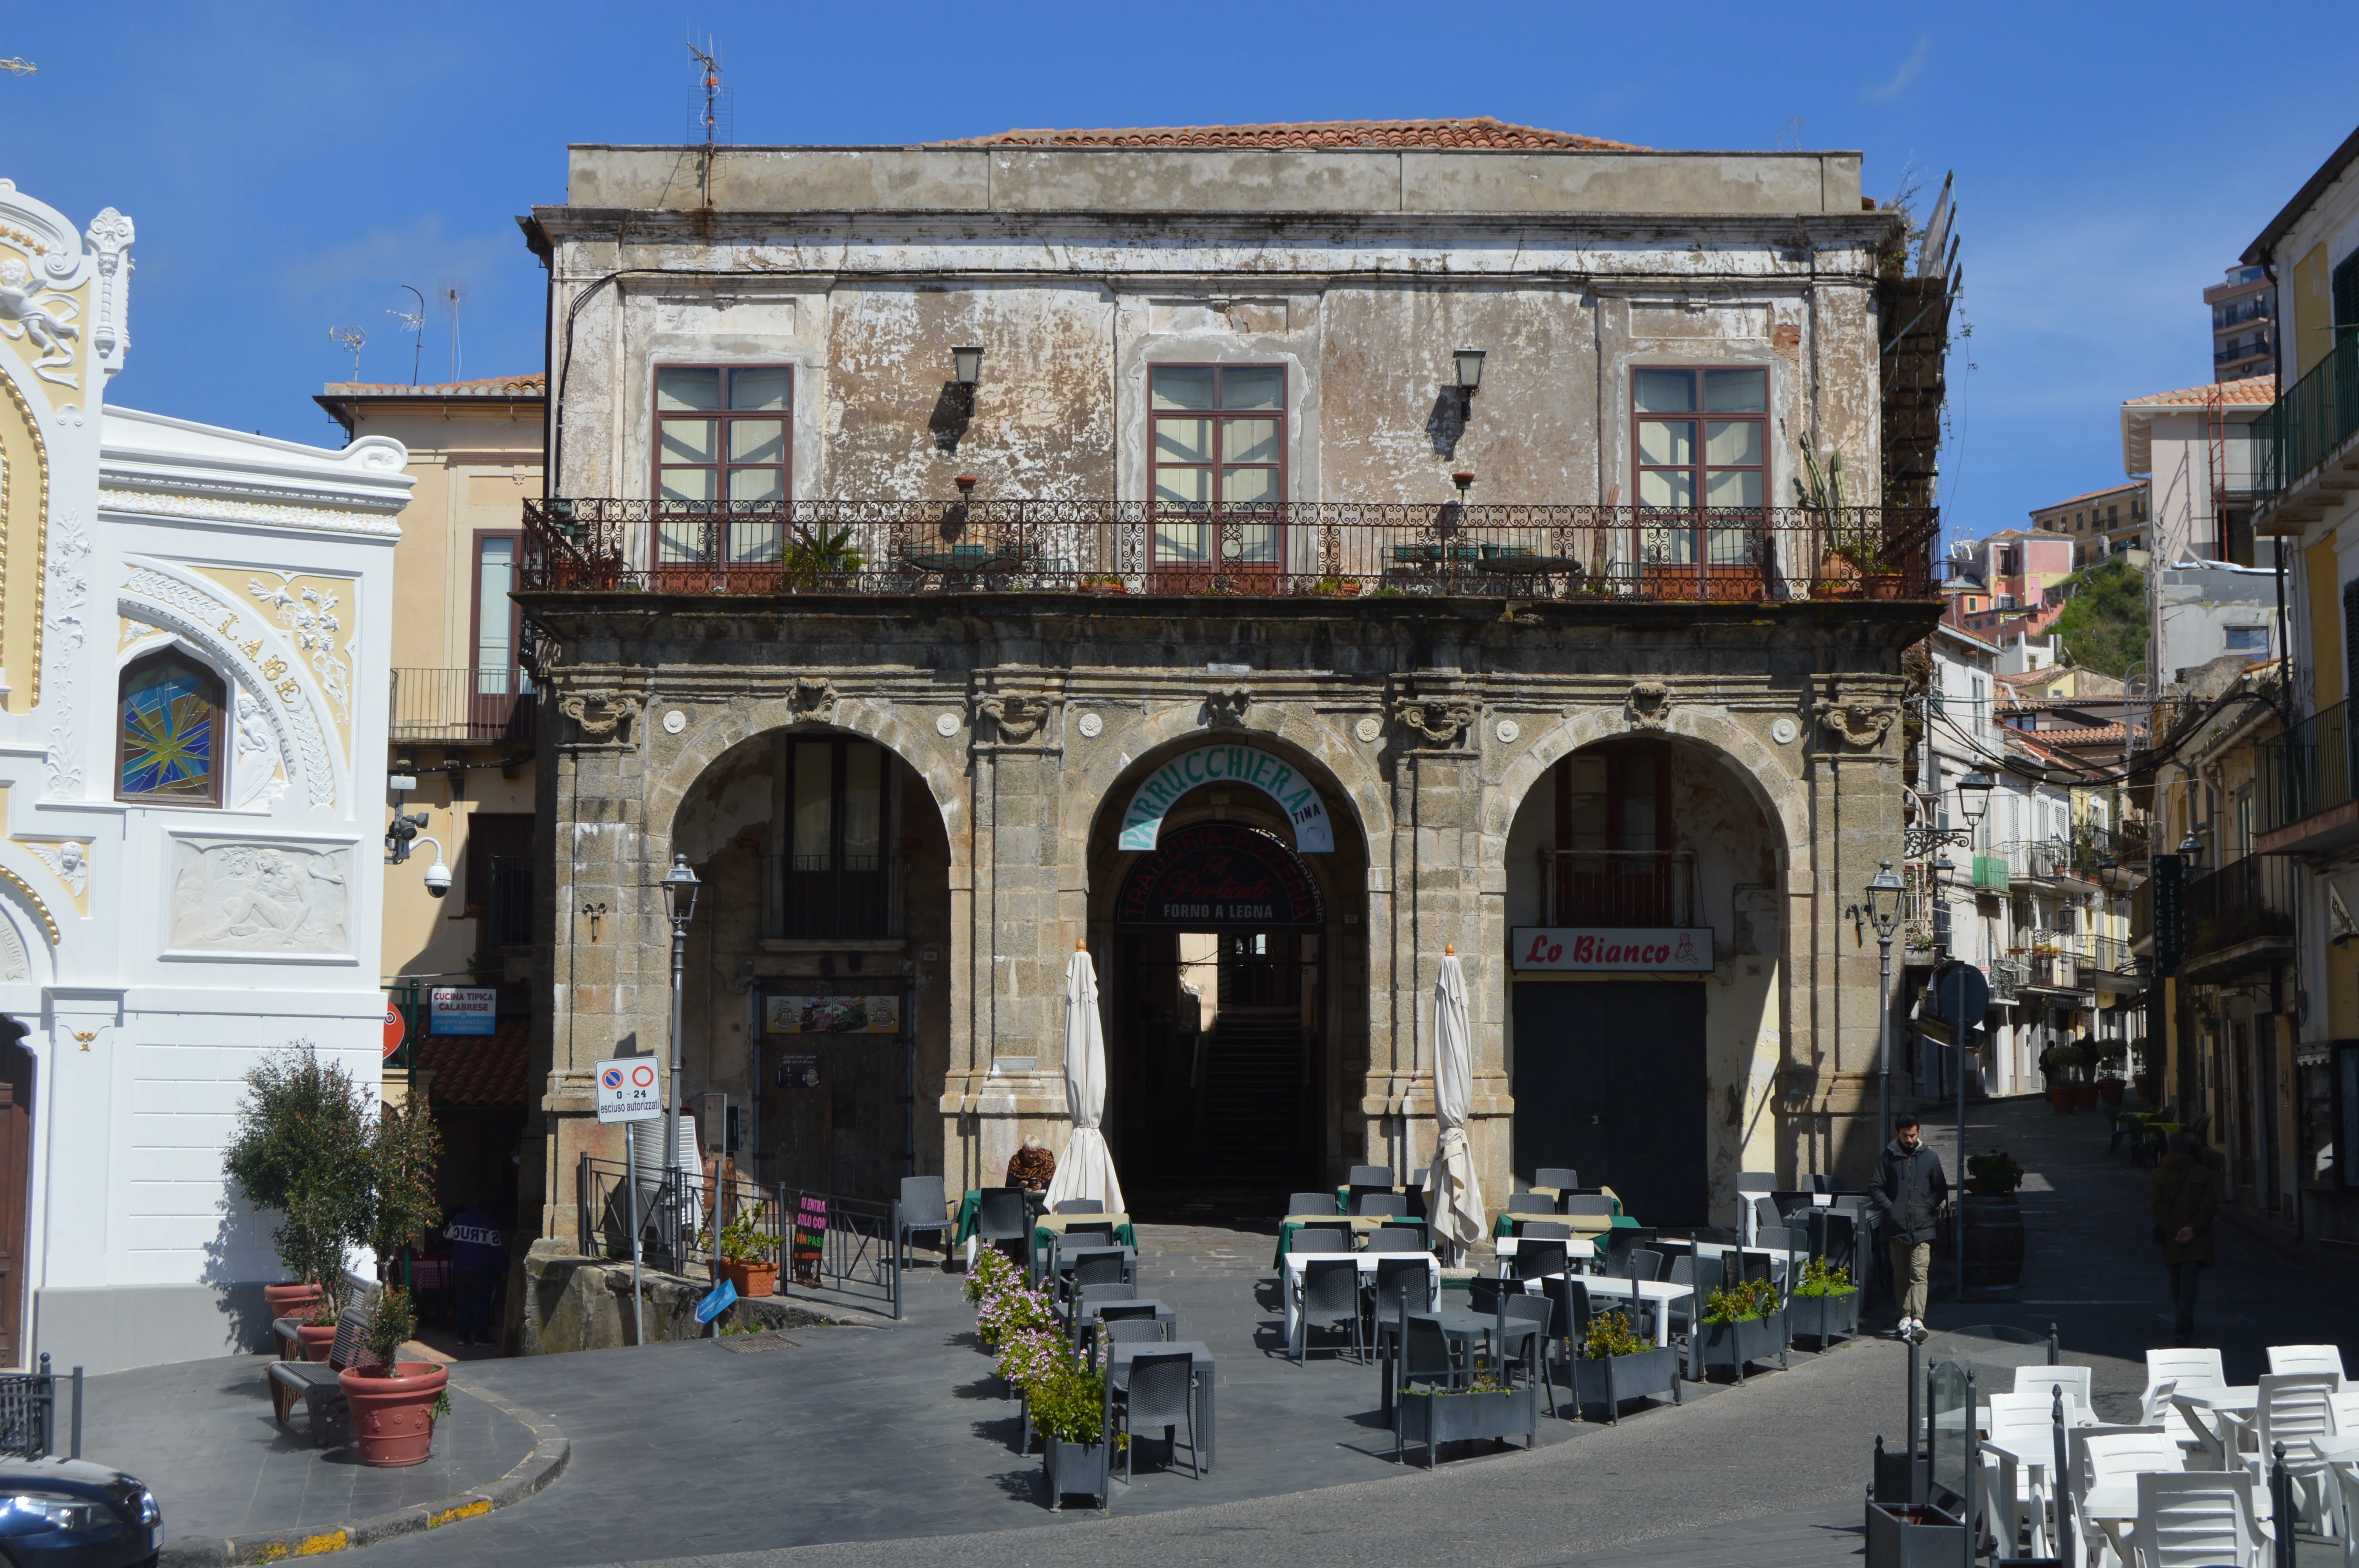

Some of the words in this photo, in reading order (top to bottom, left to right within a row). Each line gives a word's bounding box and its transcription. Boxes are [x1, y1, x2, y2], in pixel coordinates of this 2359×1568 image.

[1121, 747, 1312, 849] PARRUCCHIERA
[1292, 803, 1320, 825] TINA
[1160, 871, 1276, 901] Porticato
[1164, 904, 1209, 918] FORNO
[1215, 904, 1224, 918] A
[1230, 904, 1273, 918] LEGNA
[2154, 857, 2164, 969] PASTICCERIA
[1525, 935, 1562, 963] Lo
[1573, 935, 1670, 964] Bianco
[434, 993, 464, 1001] CUCINA
[467, 993, 494, 1001] TIPICA
[438, 1003, 488, 1011] CALABRESE
[616, 1091, 622, 1099] 0
[634, 1090, 646, 1098] 24
[600, 1102, 625, 1114] escluso
[627, 1098, 660, 1111] autorizzati
[801, 1196, 807, 1209] SI
[807, 1199, 826, 1214] ENTRA
[797, 1212, 812, 1228] SOLO
[813, 1216, 827, 1230] CON
